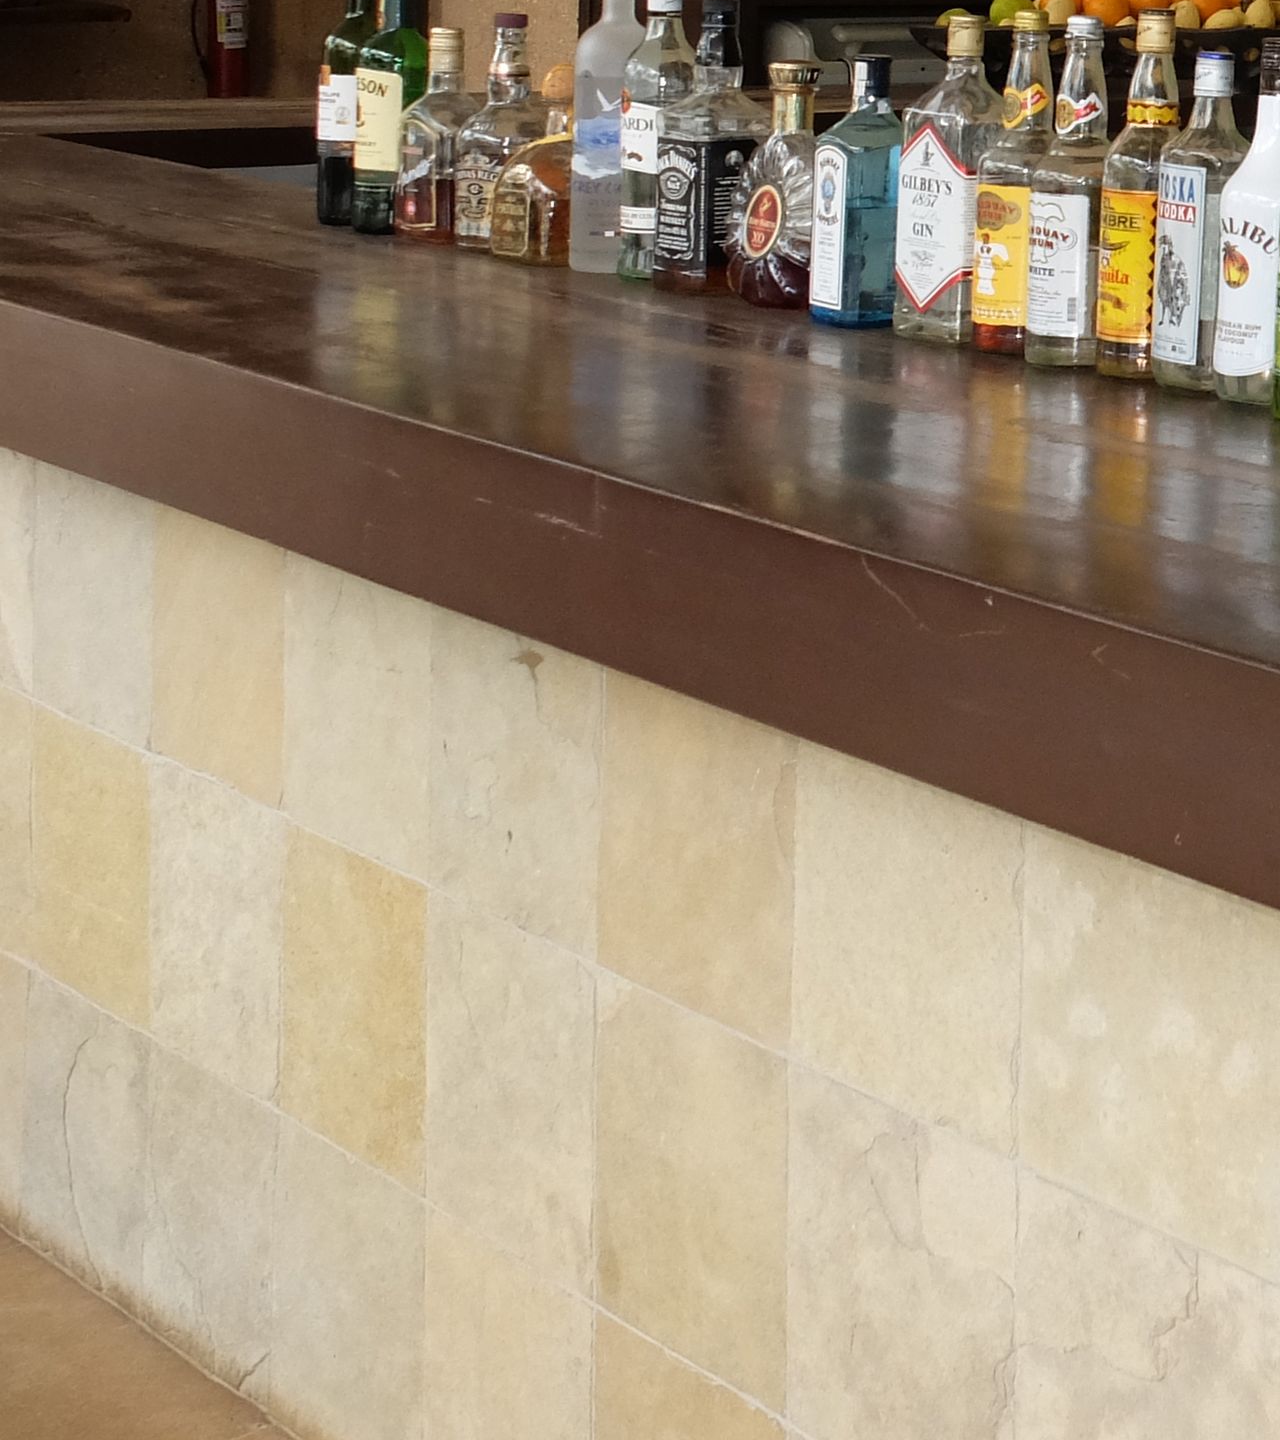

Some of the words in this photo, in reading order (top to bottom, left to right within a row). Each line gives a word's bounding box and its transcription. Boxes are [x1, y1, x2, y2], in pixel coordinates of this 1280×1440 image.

[357, 77, 389, 97] ESON
[622, 118, 653, 131] ARDI
[902, 174, 952, 195] GILBEY'S
[912, 222, 934, 238] GIN
[1221, 216, 1279, 255] ALIBU
